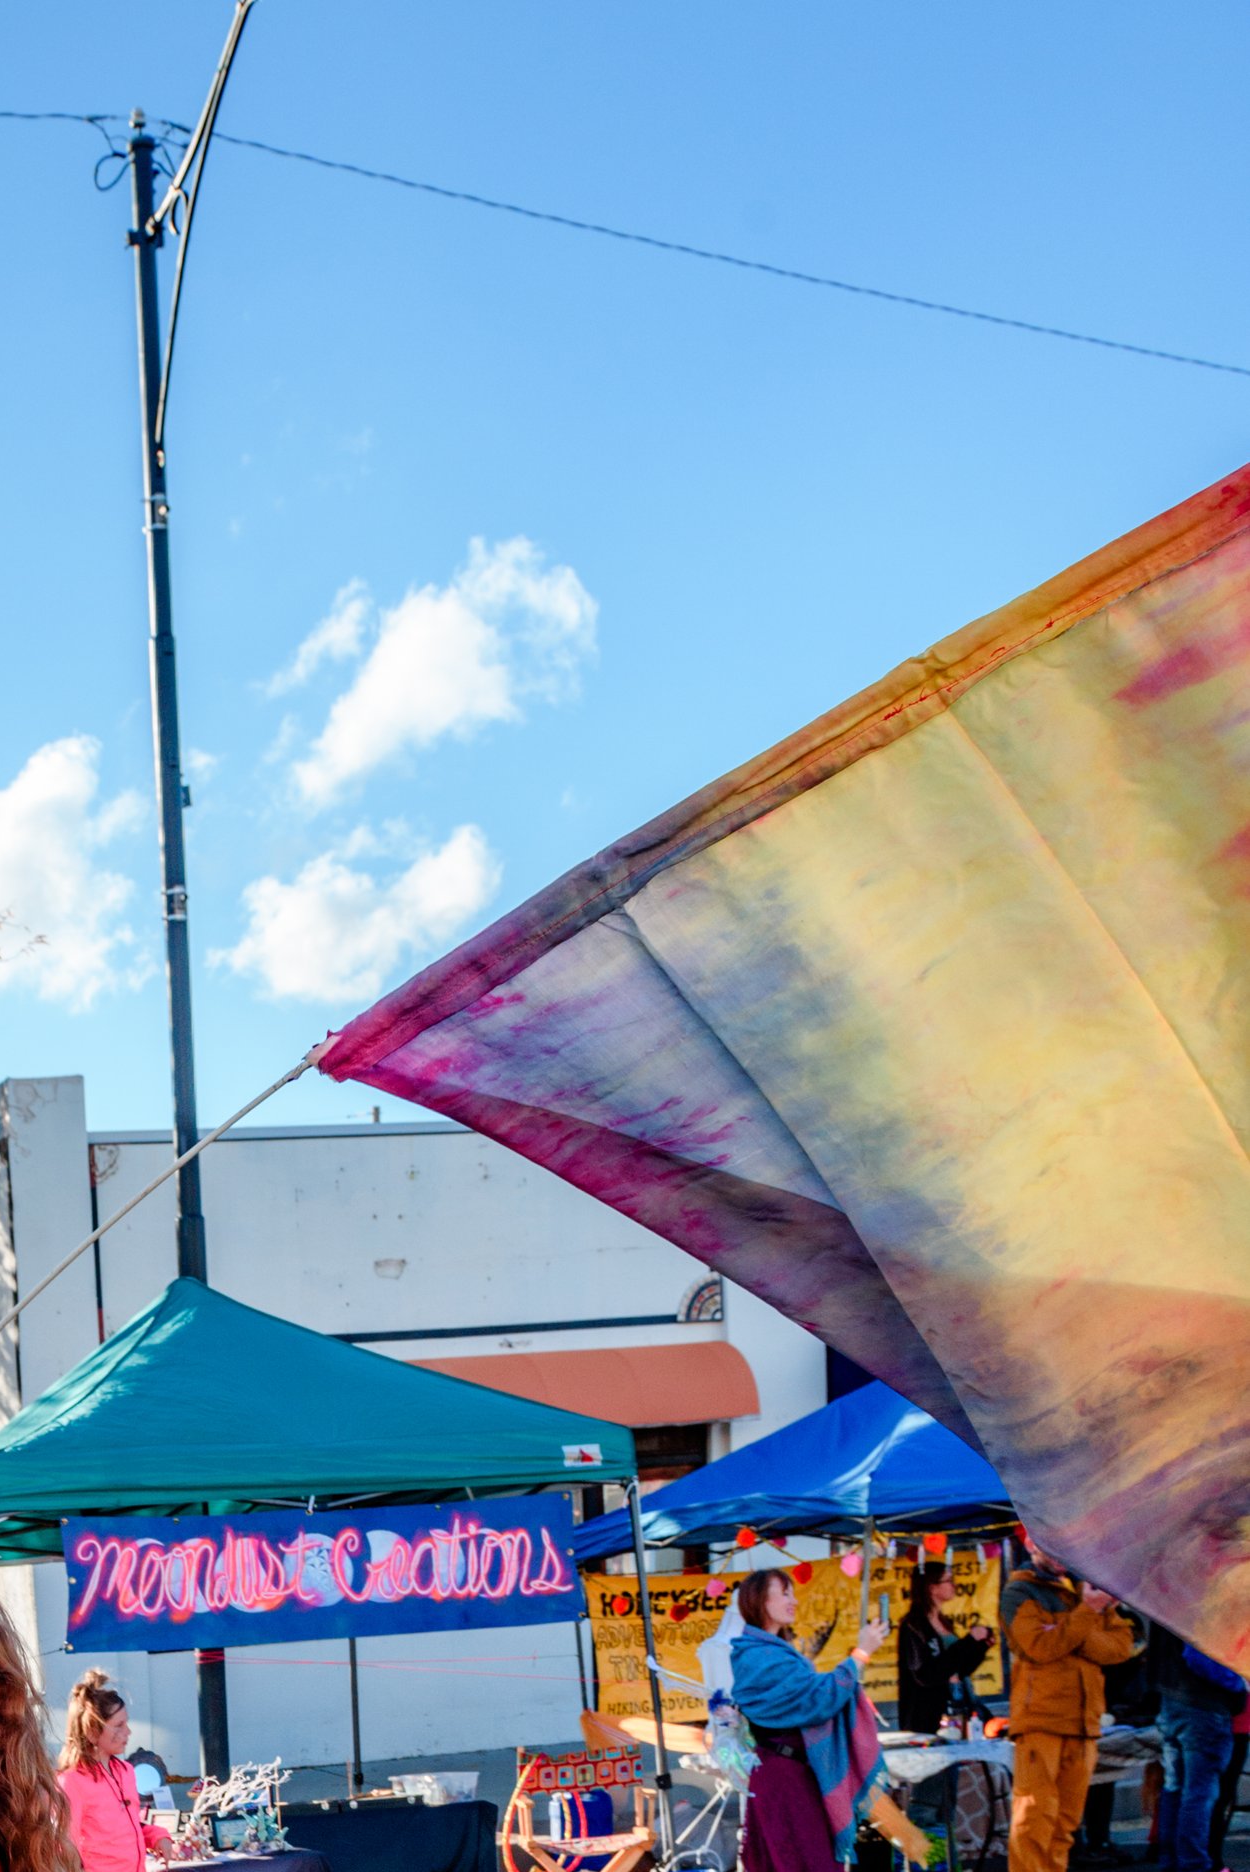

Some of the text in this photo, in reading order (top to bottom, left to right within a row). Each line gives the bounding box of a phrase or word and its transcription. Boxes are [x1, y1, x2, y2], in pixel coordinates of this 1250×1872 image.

[75, 1516, 574, 1617] Moondust Creations
[608, 1653, 664, 1684] TIM
[660, 1696, 704, 1713] ADVEN
